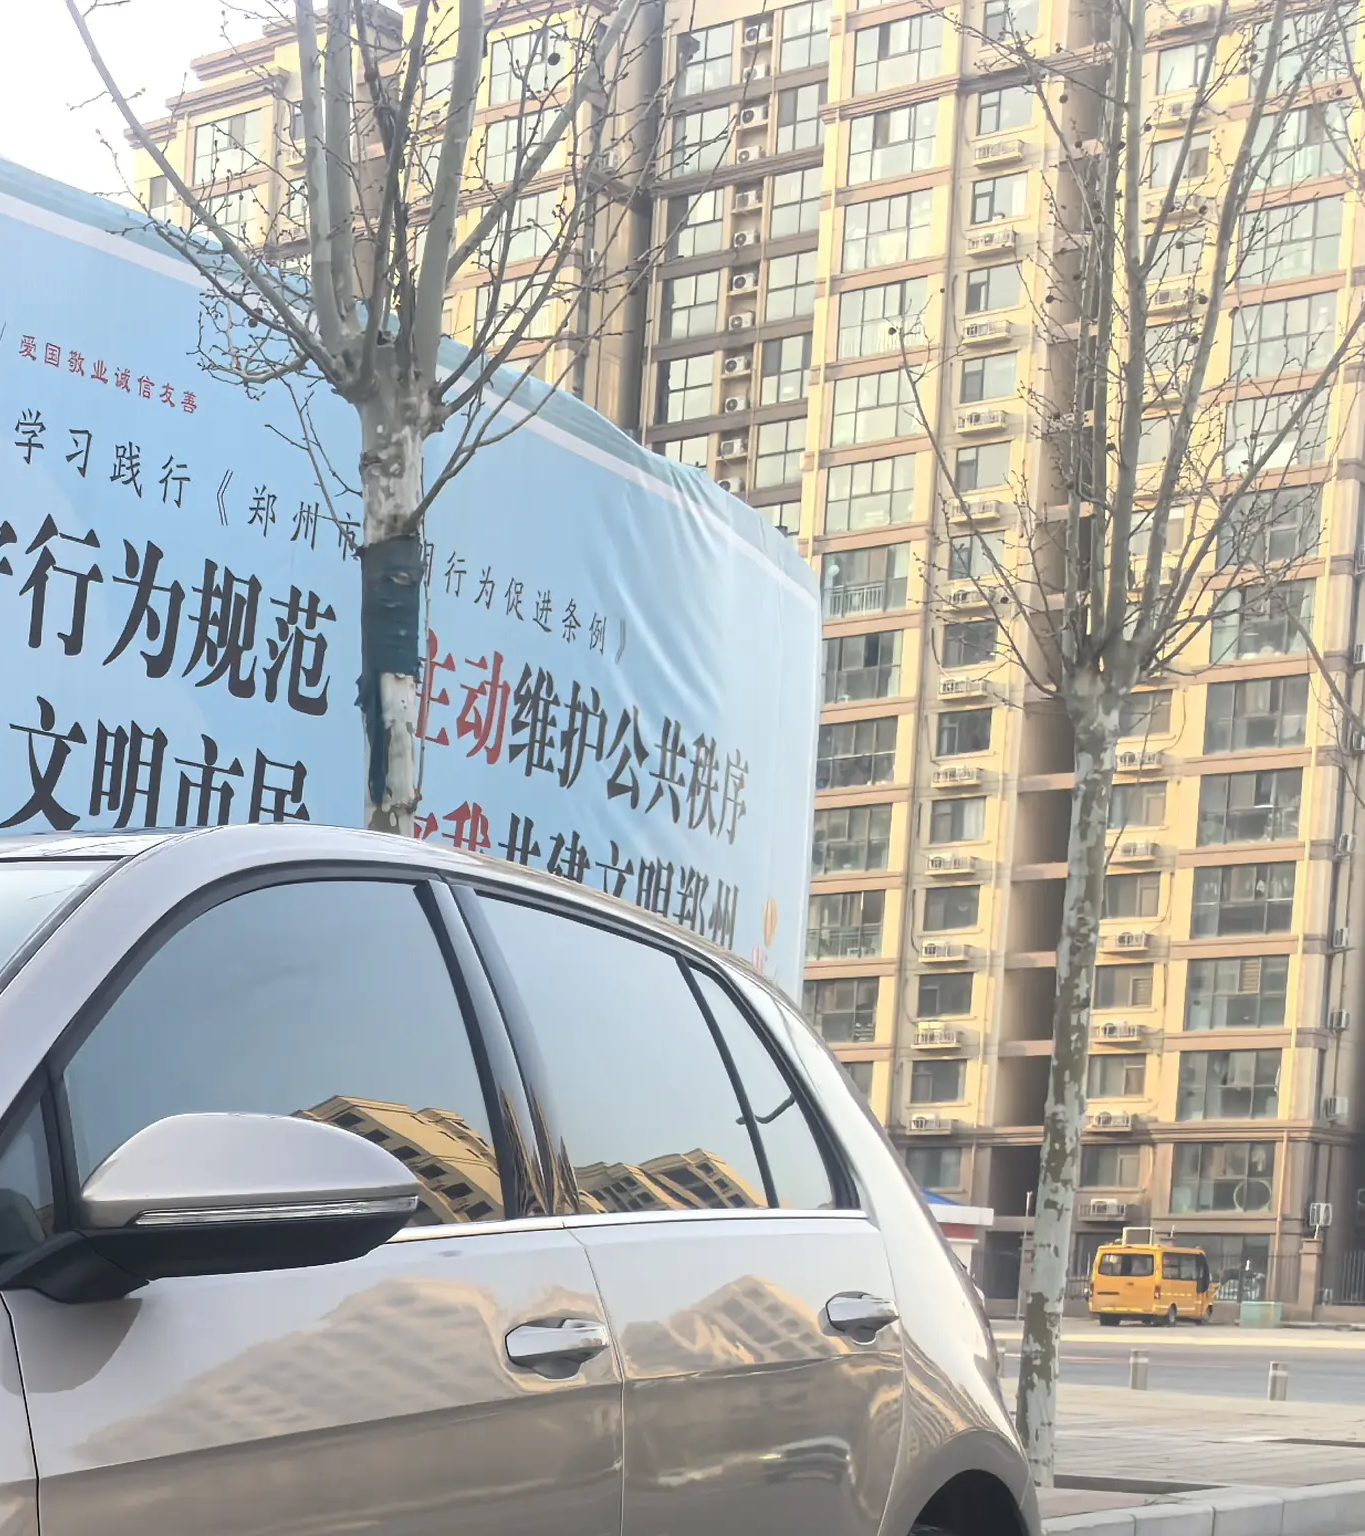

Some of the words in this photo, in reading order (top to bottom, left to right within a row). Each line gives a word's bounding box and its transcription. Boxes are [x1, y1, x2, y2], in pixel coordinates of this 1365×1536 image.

[19, 334, 199, 415] 爱国敬业诚信友善
